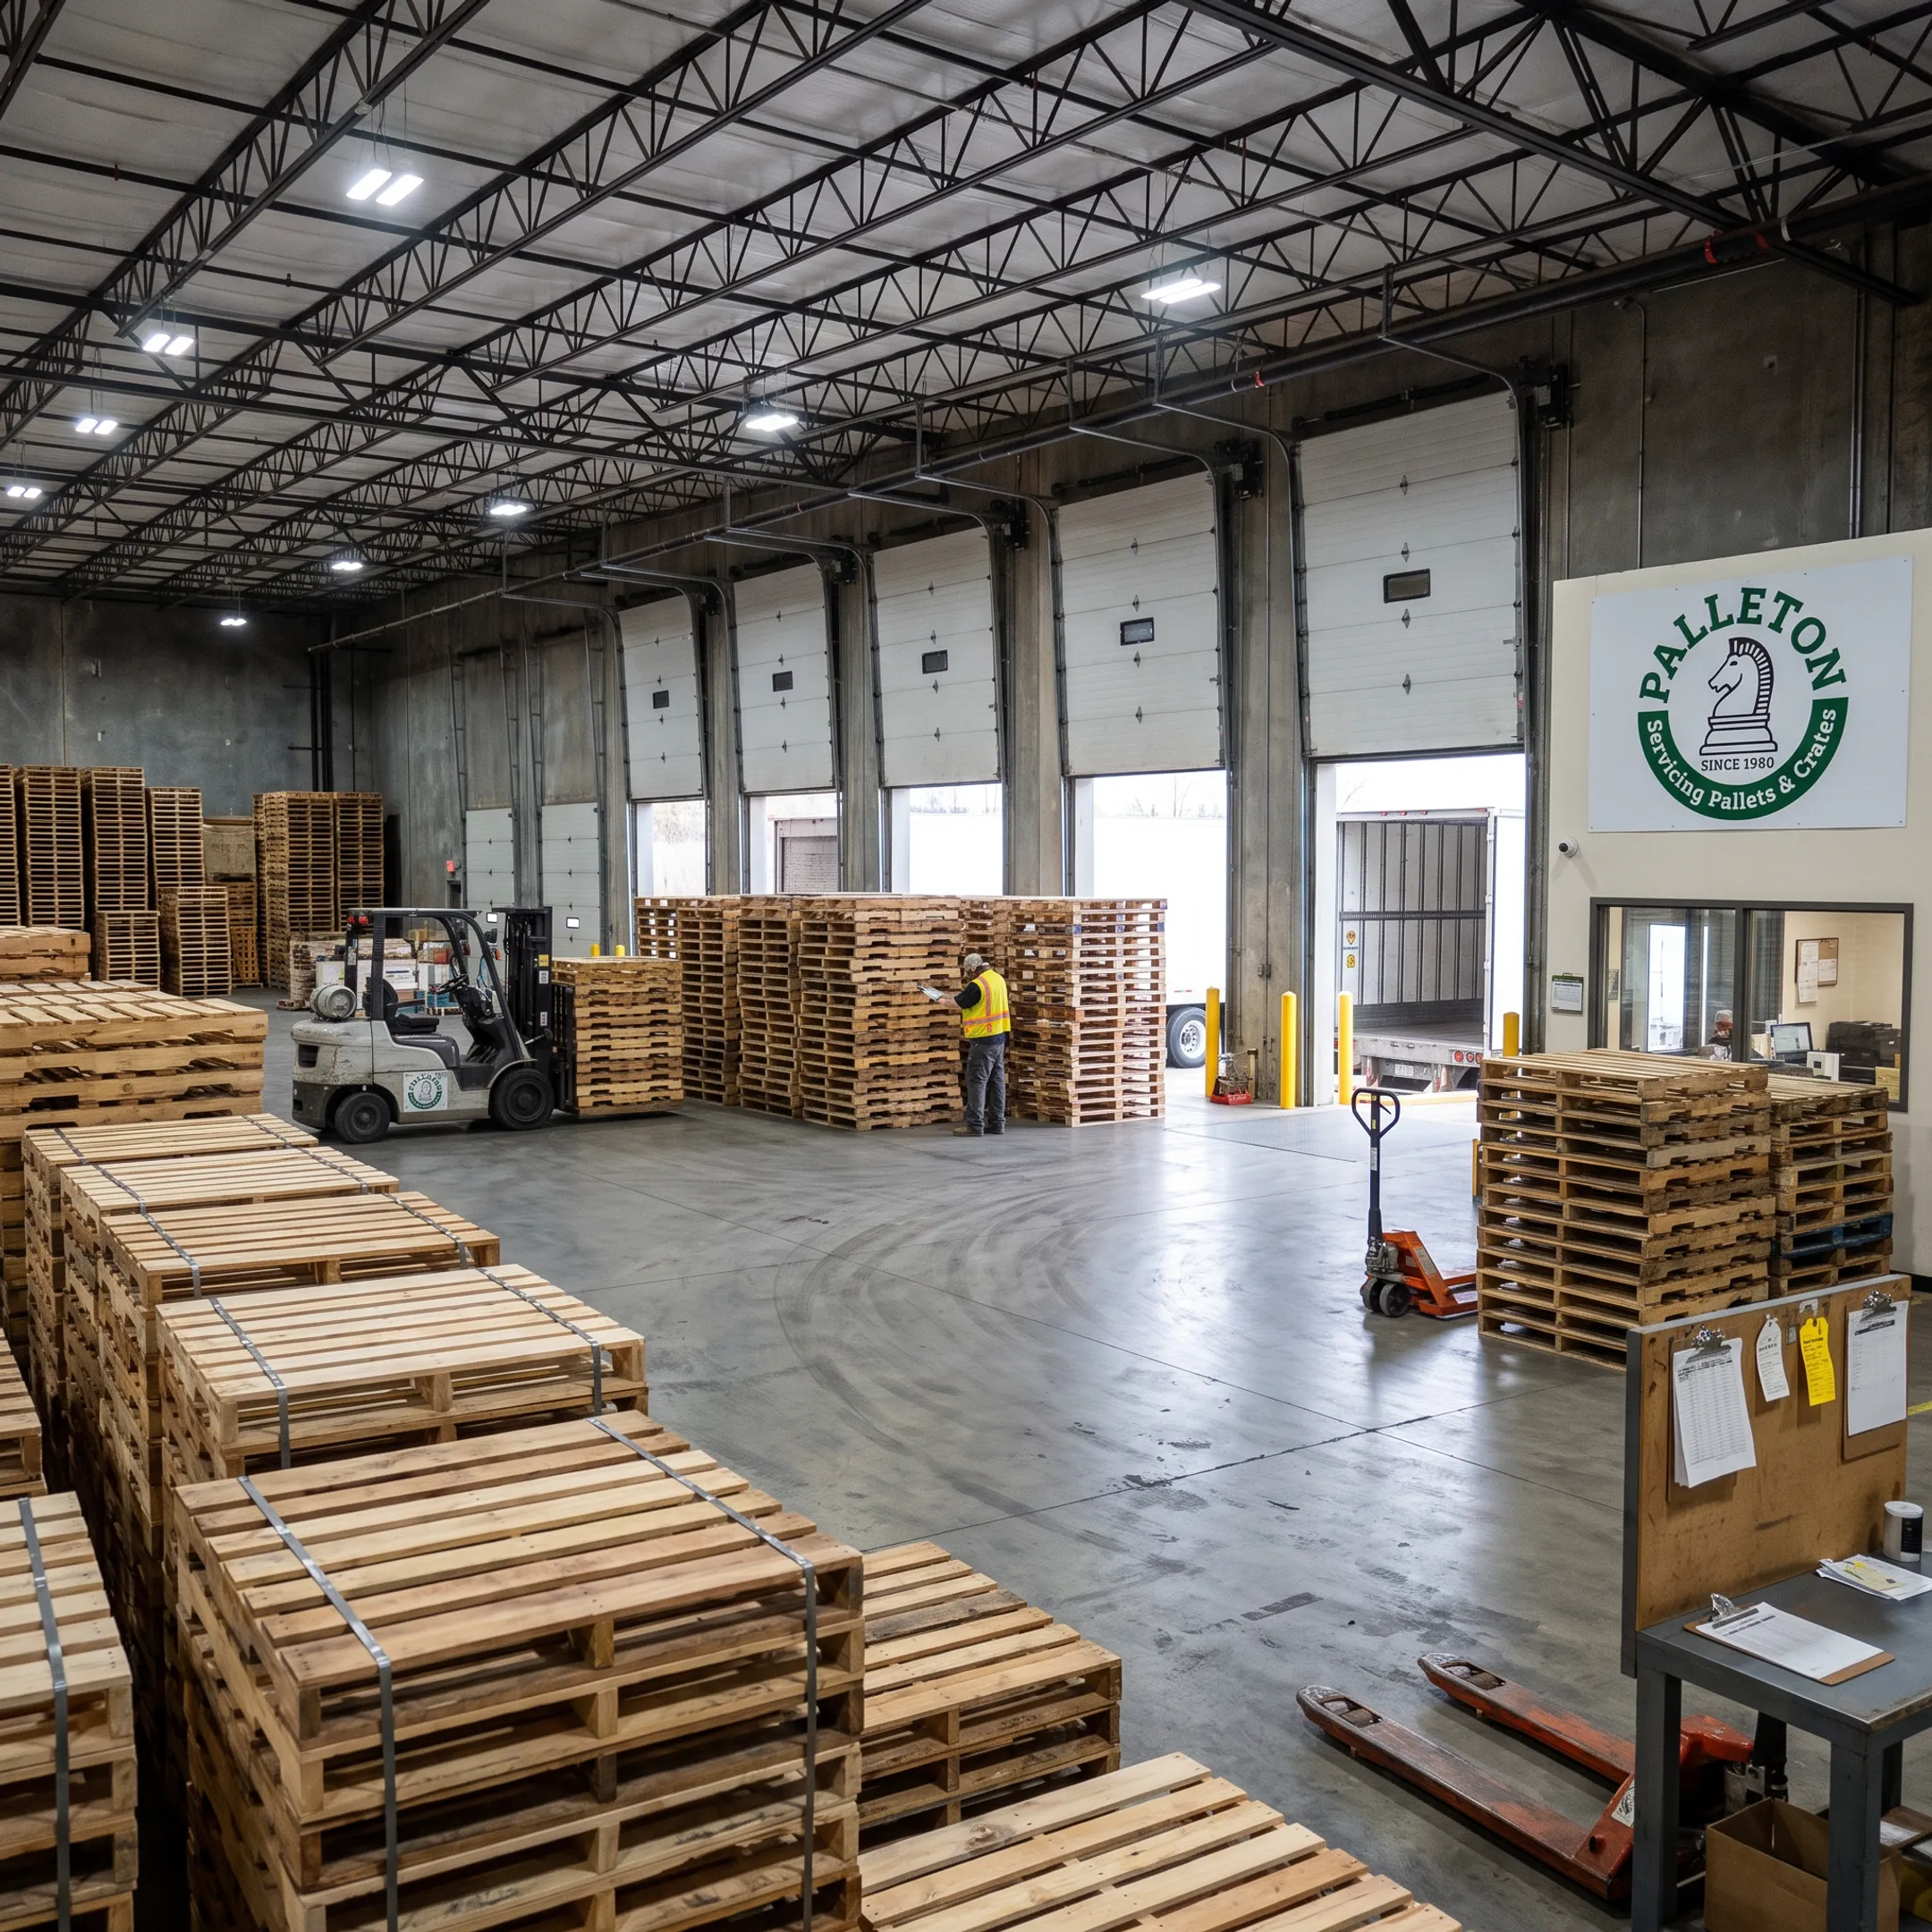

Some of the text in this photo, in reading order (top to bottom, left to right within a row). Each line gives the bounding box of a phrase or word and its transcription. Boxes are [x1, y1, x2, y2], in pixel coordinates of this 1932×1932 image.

[1639, 587, 1846, 703] PALLETON
[1647, 708, 1836, 810] Servicing Pallets & Crates
[1700, 757, 1775, 771] SINCE 1980
